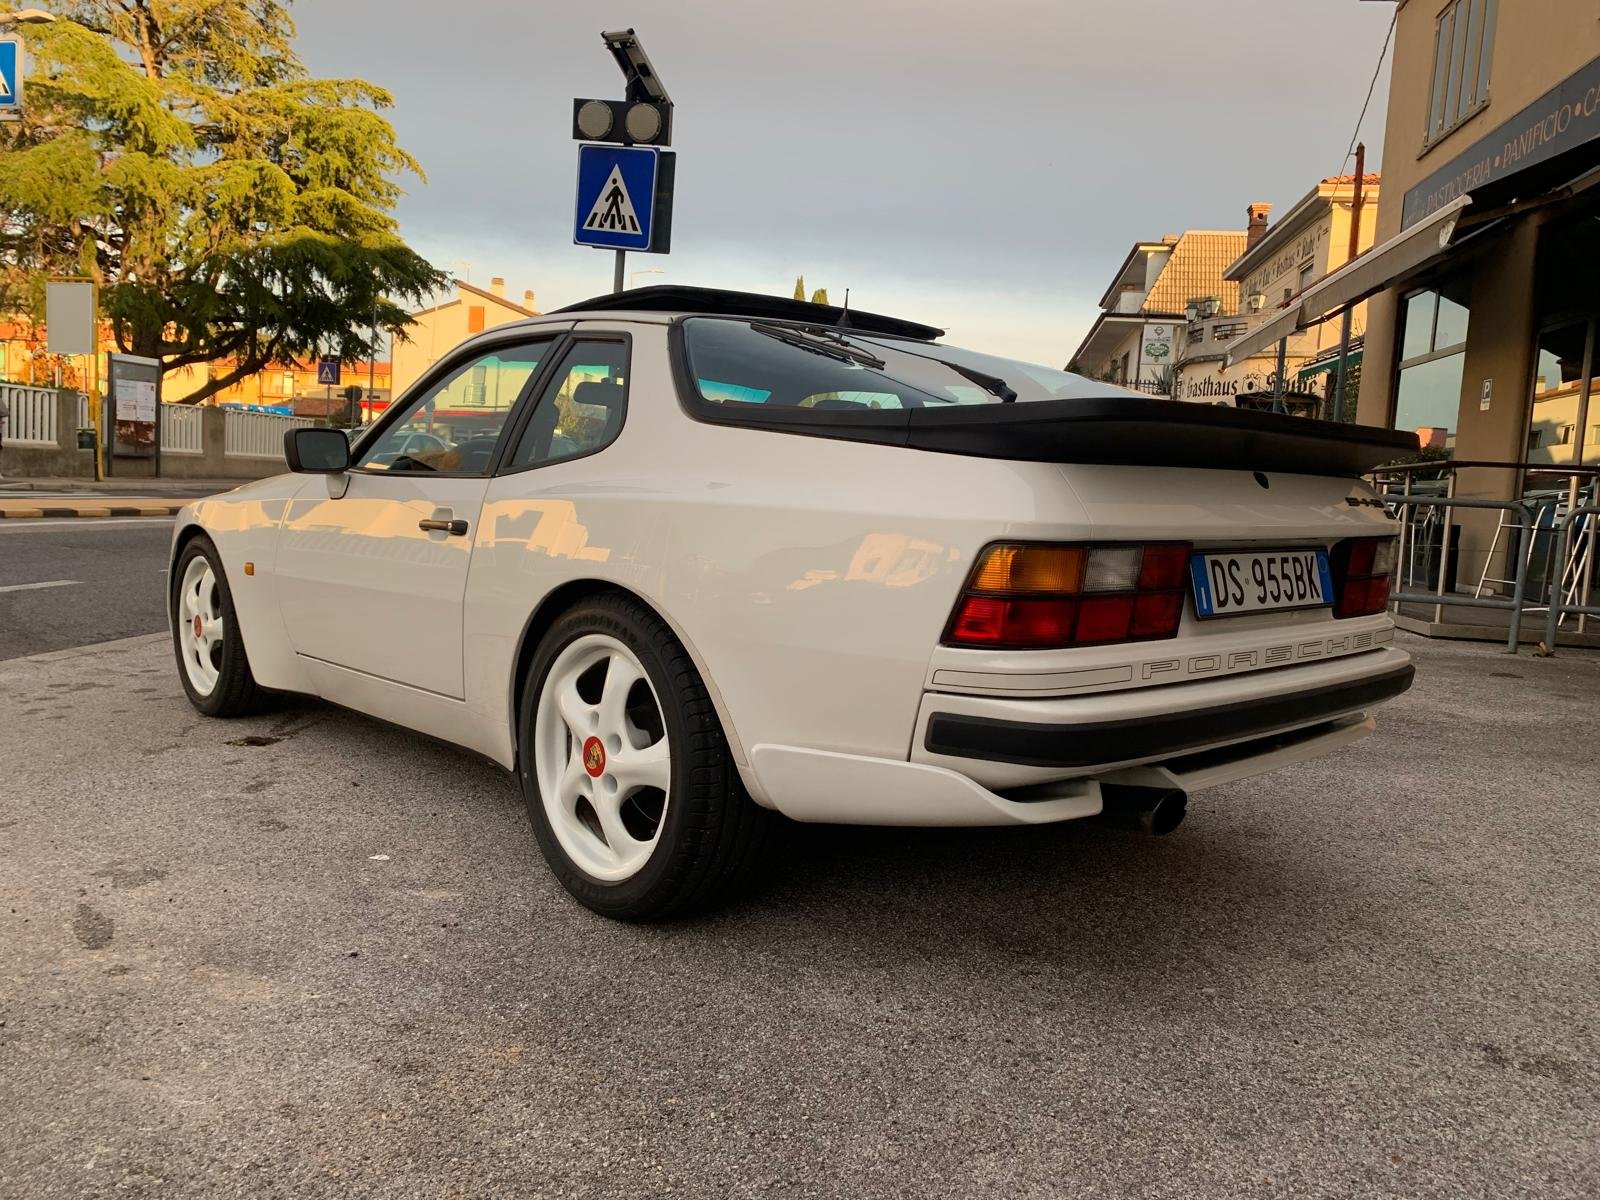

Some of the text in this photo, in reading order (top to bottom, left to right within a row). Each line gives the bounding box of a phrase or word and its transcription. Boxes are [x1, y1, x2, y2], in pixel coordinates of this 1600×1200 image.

[1502, 104, 1571, 168] PANIFICIO
[1186, 371, 1318, 398] Gasthaus Sube
[1483, 381, 1490, 398] P
[1210, 558, 1244, 608] DS
[1251, 556, 1320, 604] 955BK
[1142, 633, 1373, 680] PORSCHE
